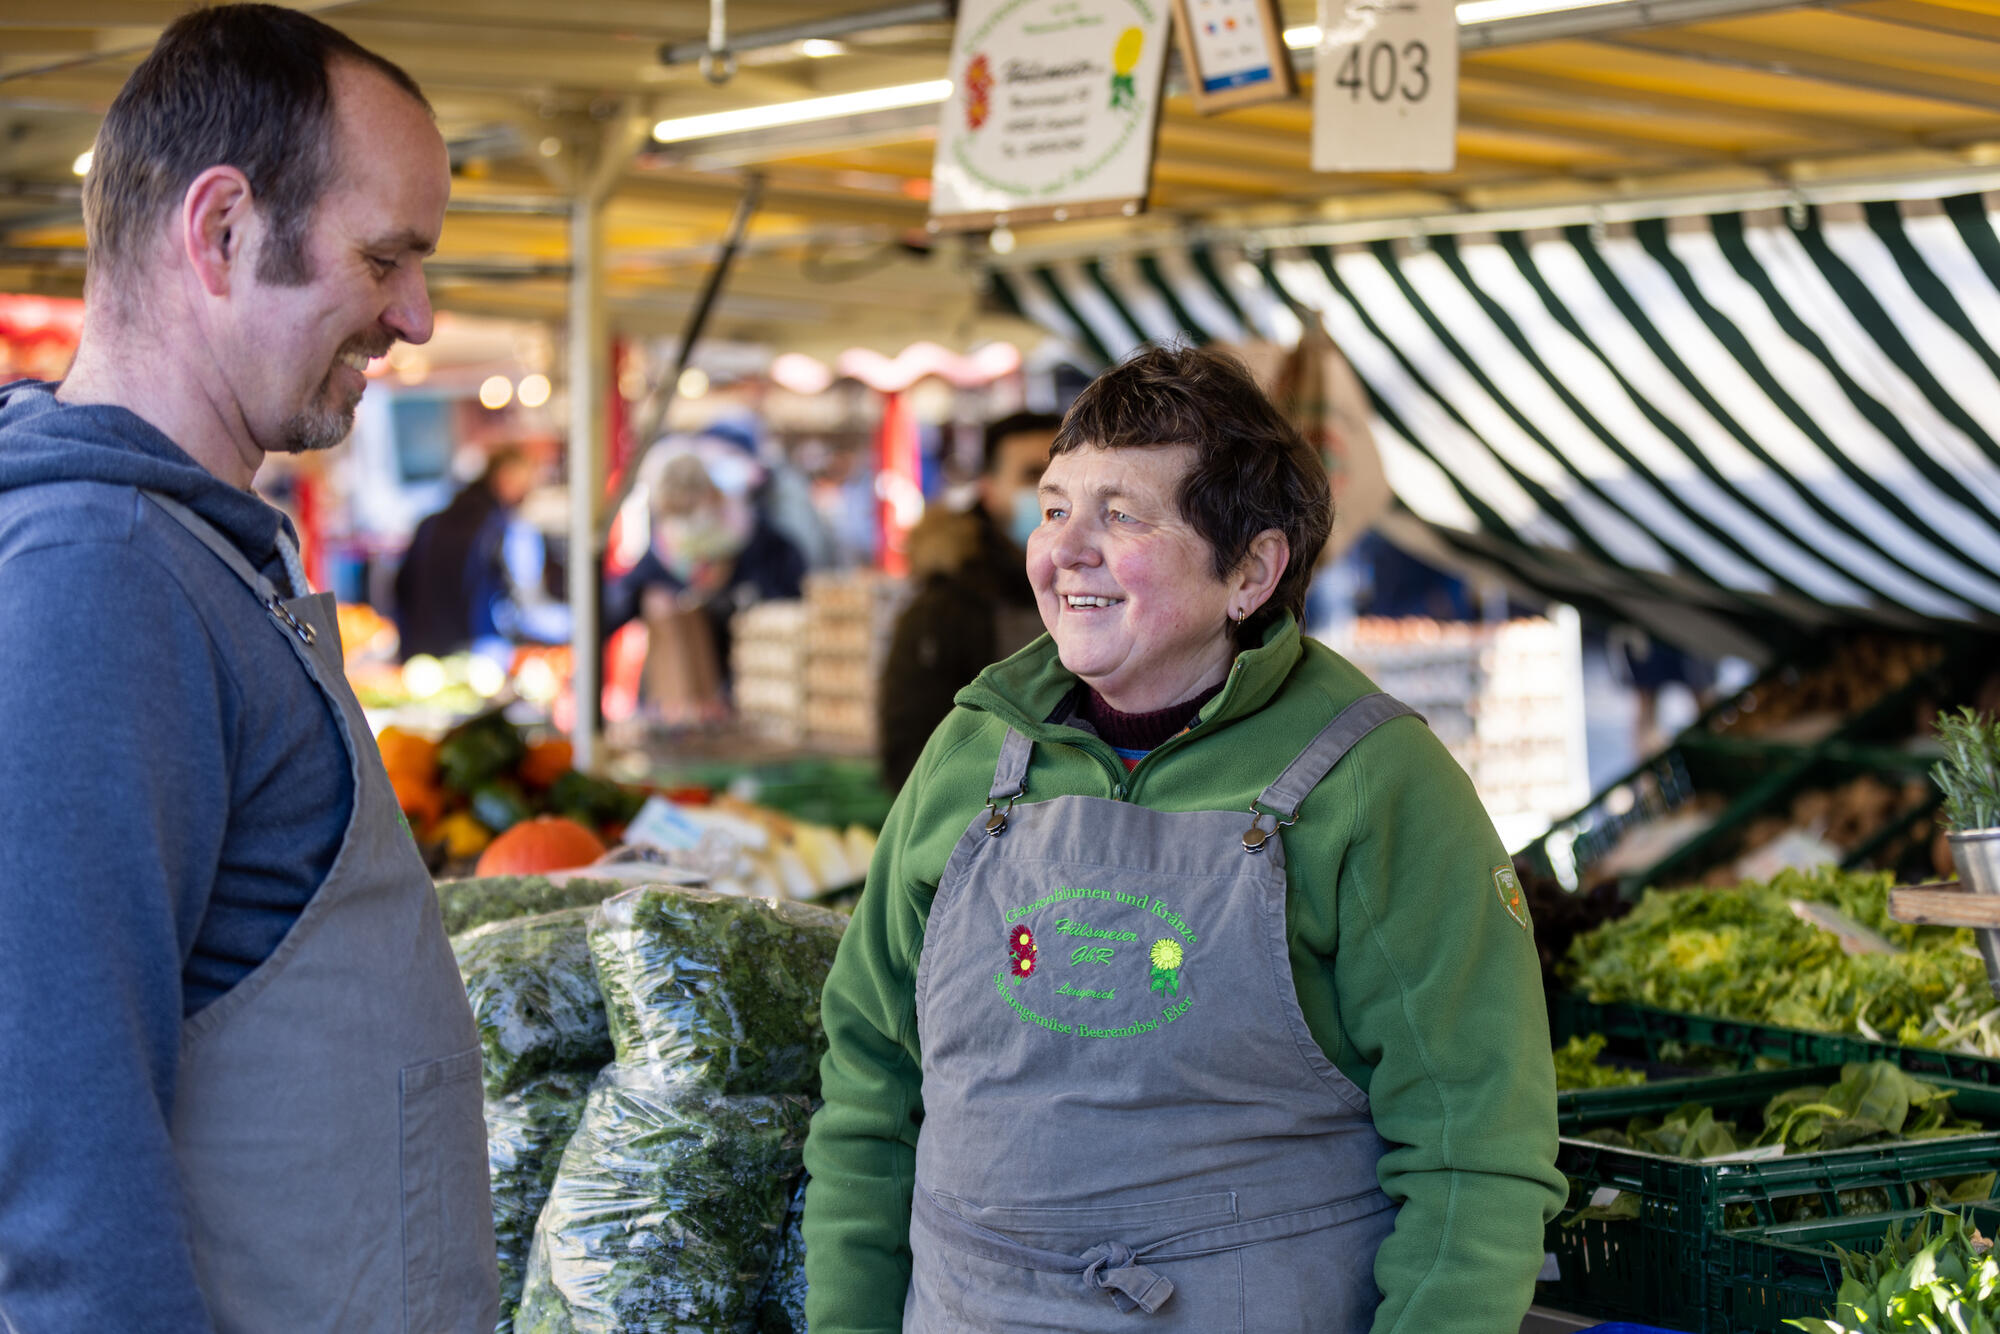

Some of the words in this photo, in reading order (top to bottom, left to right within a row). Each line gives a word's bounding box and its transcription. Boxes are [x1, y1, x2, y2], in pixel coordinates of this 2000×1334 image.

[1335, 41, 1430, 101] 403
[1006, 886, 1111, 923] Gartenblumen
[1116, 892, 1149, 909] und
[1150, 900, 1197, 944] Kränze
[1055, 918, 1137, 942] Hülsmeier
[1071, 945, 1114, 966] GbR
[993, 972, 1071, 1034] Saisongemüse
[1162, 996, 1192, 1022] Eier
